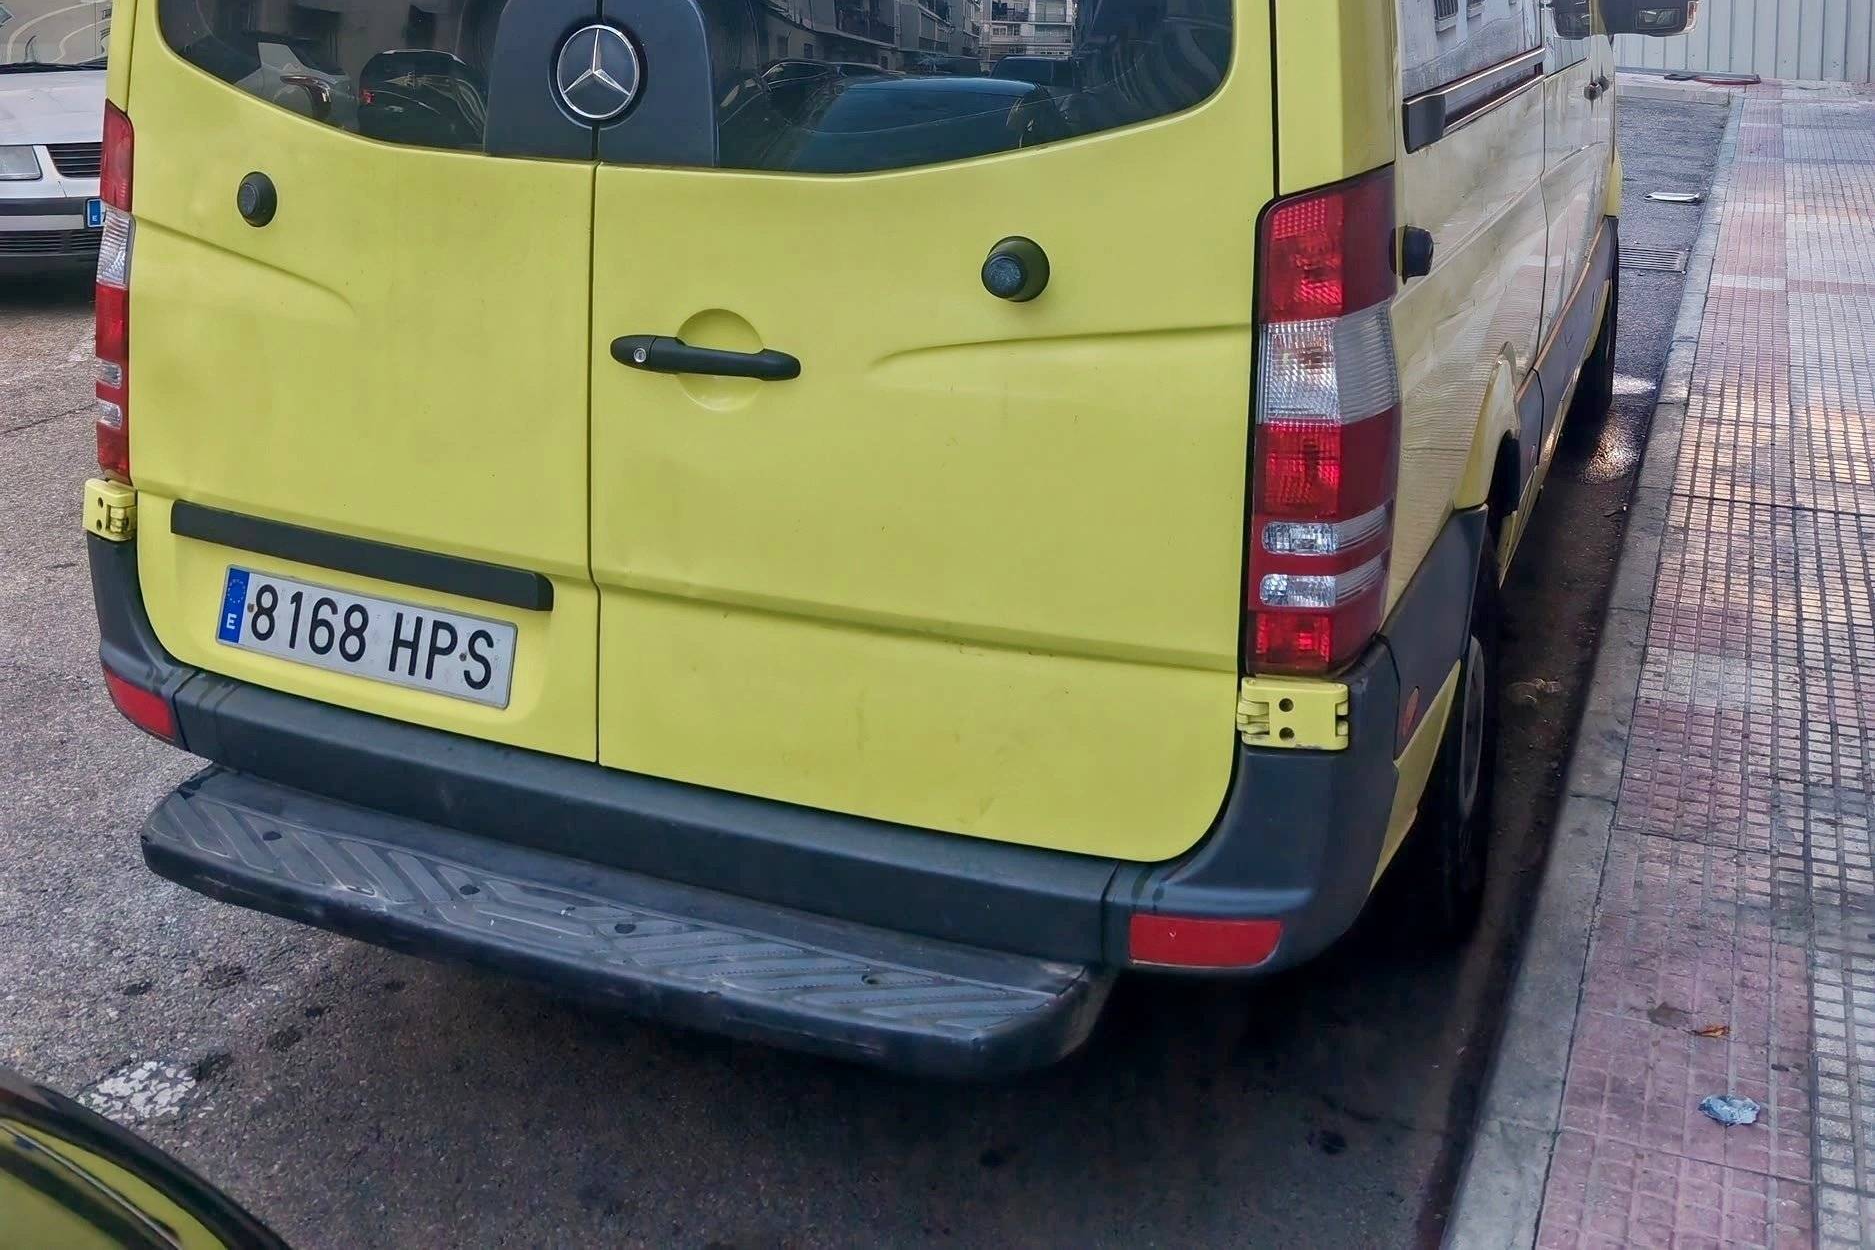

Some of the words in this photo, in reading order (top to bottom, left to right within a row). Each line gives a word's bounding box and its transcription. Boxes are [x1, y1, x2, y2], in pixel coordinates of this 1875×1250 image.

[226, 613, 237, 630] E
[251, 584, 369, 662] 8168
[388, 612, 494, 690] HPS
